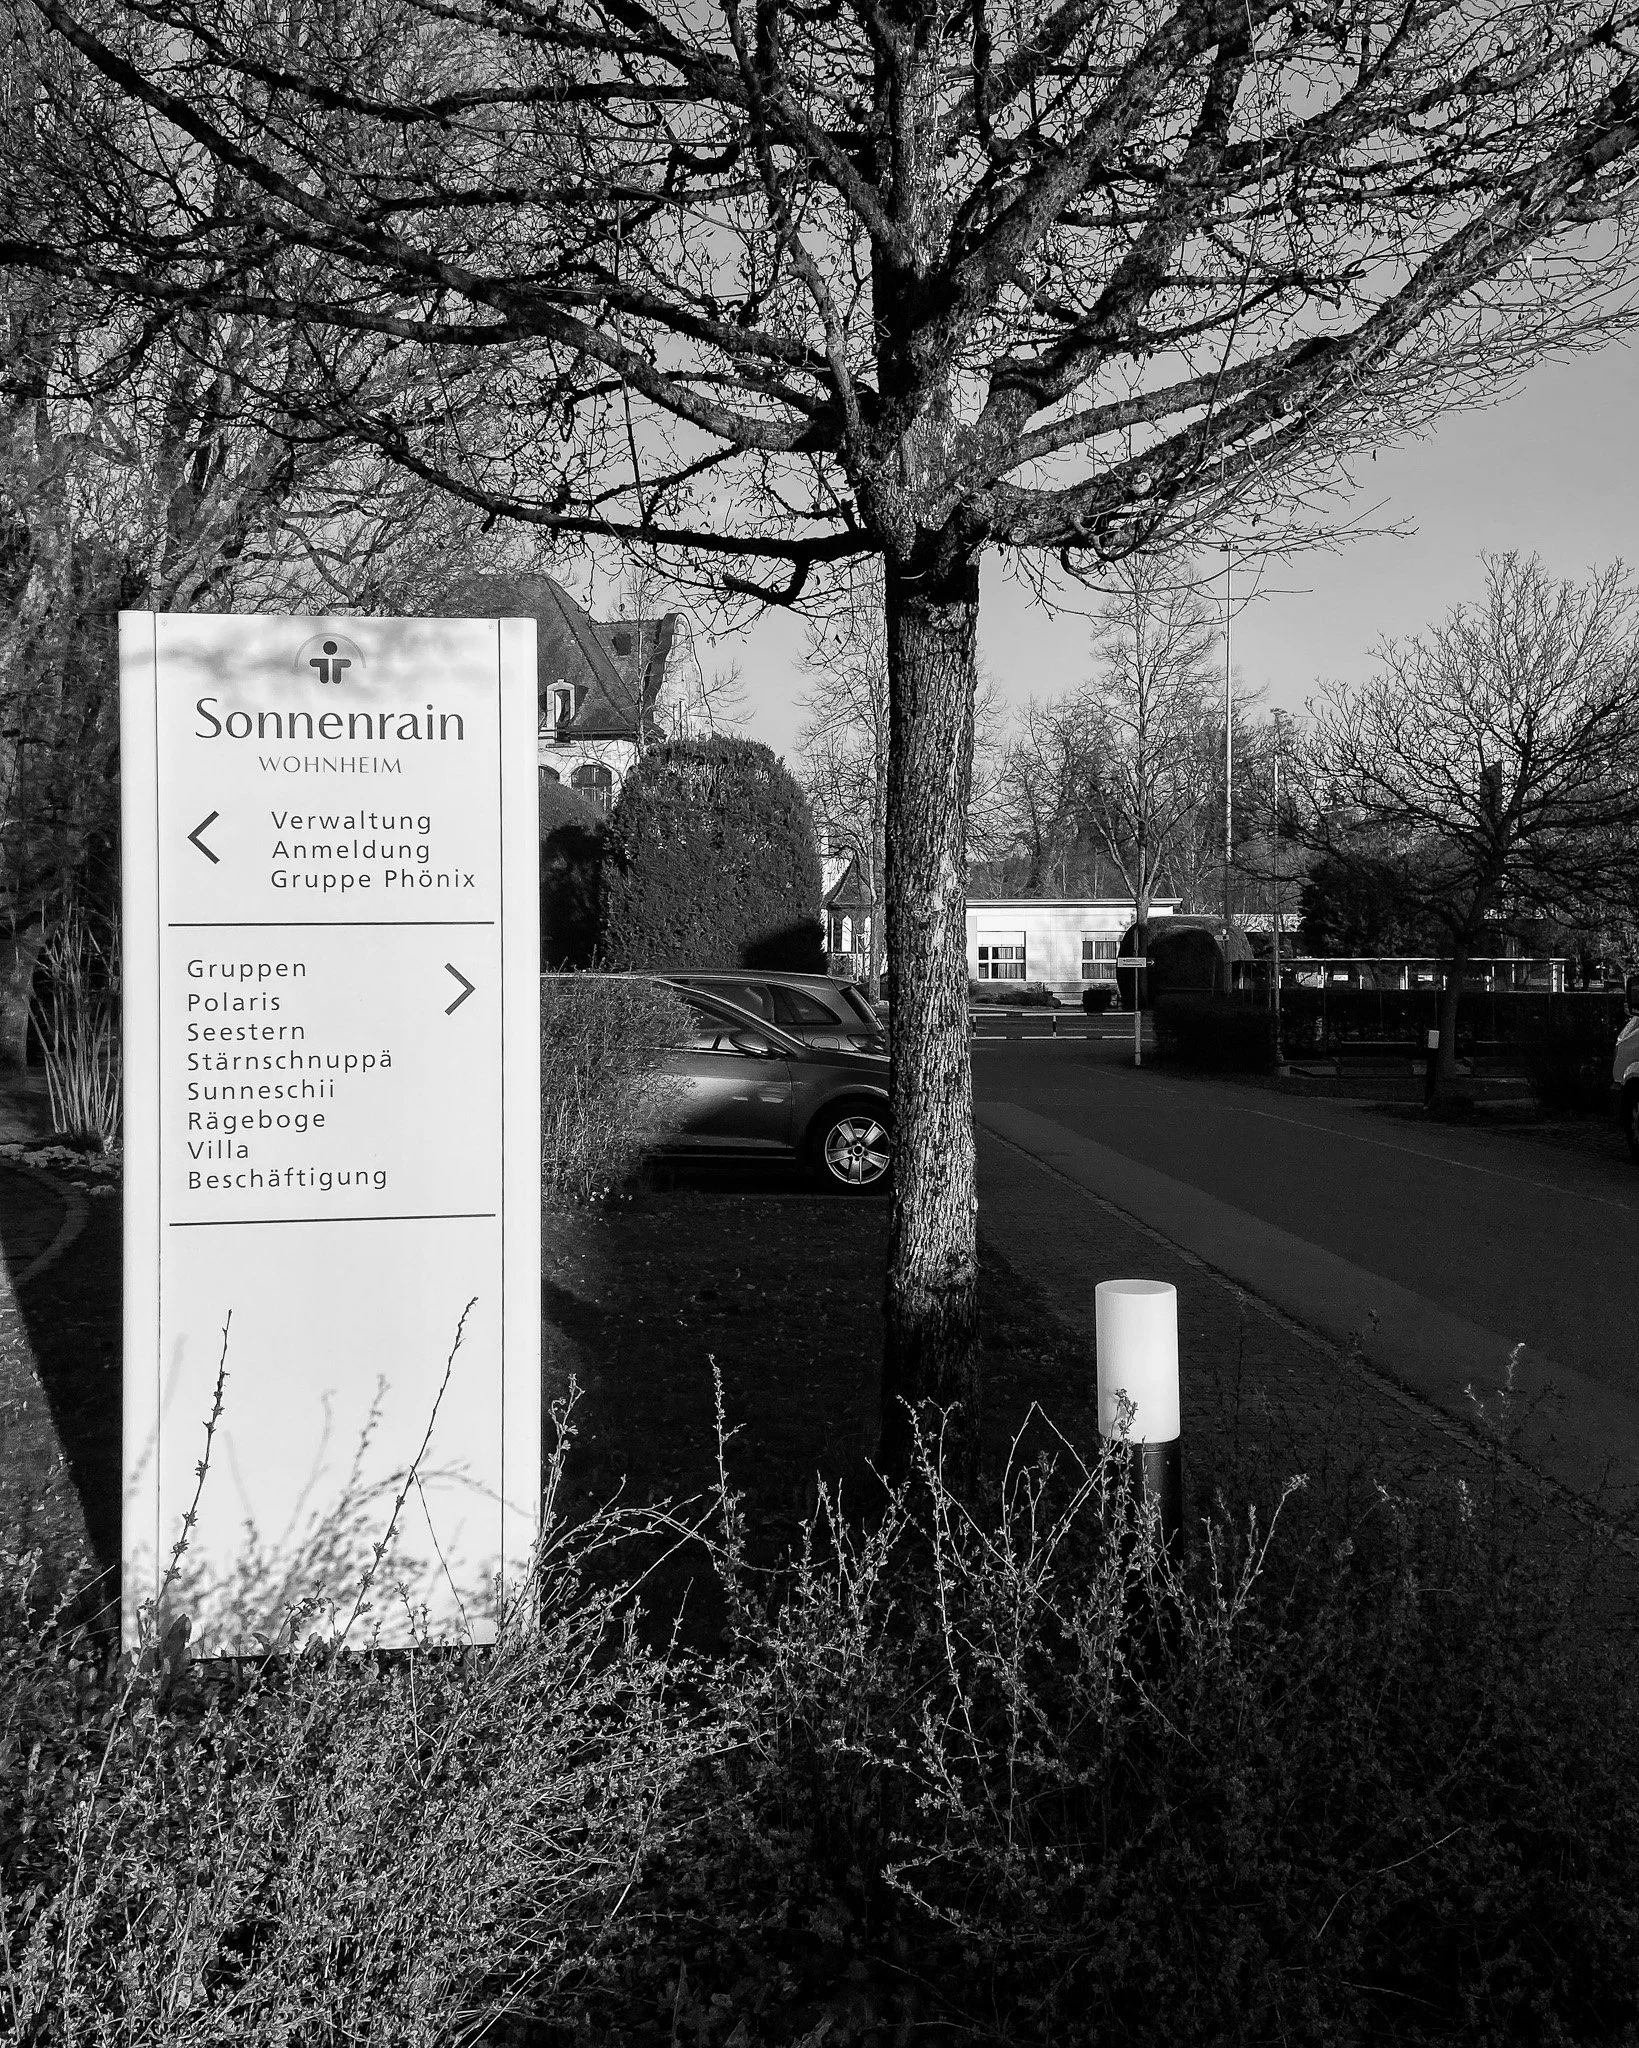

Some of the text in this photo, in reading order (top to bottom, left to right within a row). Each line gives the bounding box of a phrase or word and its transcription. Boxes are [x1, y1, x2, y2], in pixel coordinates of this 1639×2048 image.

[195, 697, 464, 741] Sonnenrain
[258, 755, 402, 774] WOHNHEIM
[271, 809, 431, 834] Verwaltung
[271, 839, 430, 864] Anmeldung
[271, 868, 475, 892] Gruppe Phönix
[187, 959, 306, 983] Gruppen
[188, 991, 280, 1012] Polaris
[187, 1022, 305, 1042] Seestern
[187, 1049, 392, 1073] Stärnschnuppä
[187, 1078, 334, 1101] Sunneschii
[188, 1109, 326, 1132] Rägeboge
[187, 1139, 249, 1160] Villa
[188, 1166, 387, 1191] Beschäftigung
